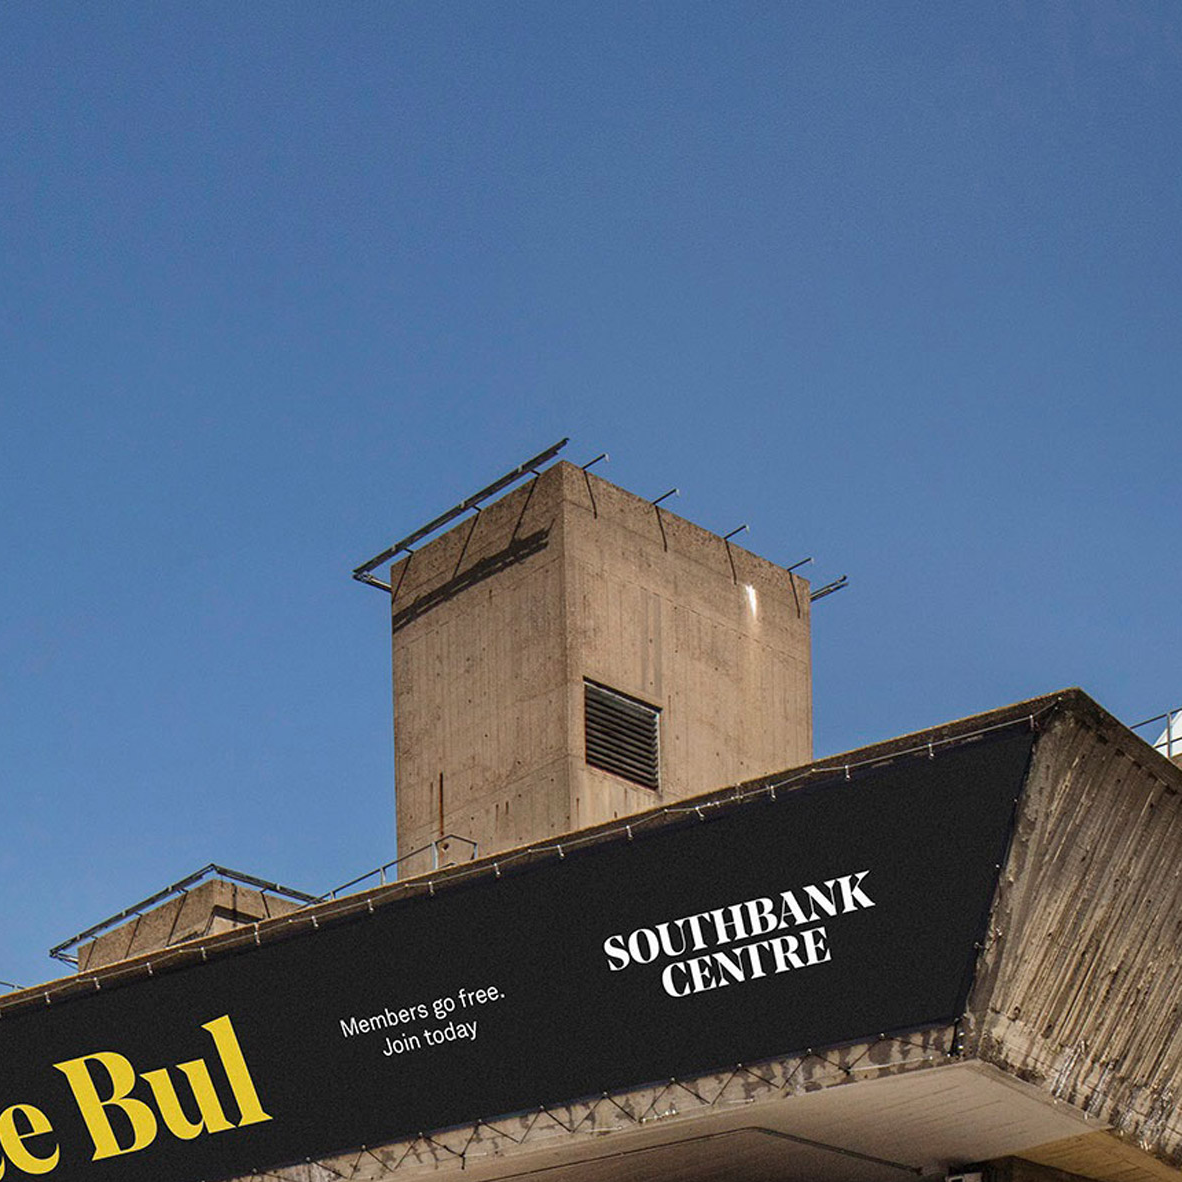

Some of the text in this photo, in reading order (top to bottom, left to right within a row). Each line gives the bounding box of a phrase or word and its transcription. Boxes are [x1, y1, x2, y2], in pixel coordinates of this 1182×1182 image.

[603, 870, 876, 971] SOUTHBANK
[661, 926, 832, 998] CENTRE
[339, 986, 506, 1038] Members go free.
[382, 1021, 477, 1057] Join today
[53, 1014, 273, 1161] Bul
